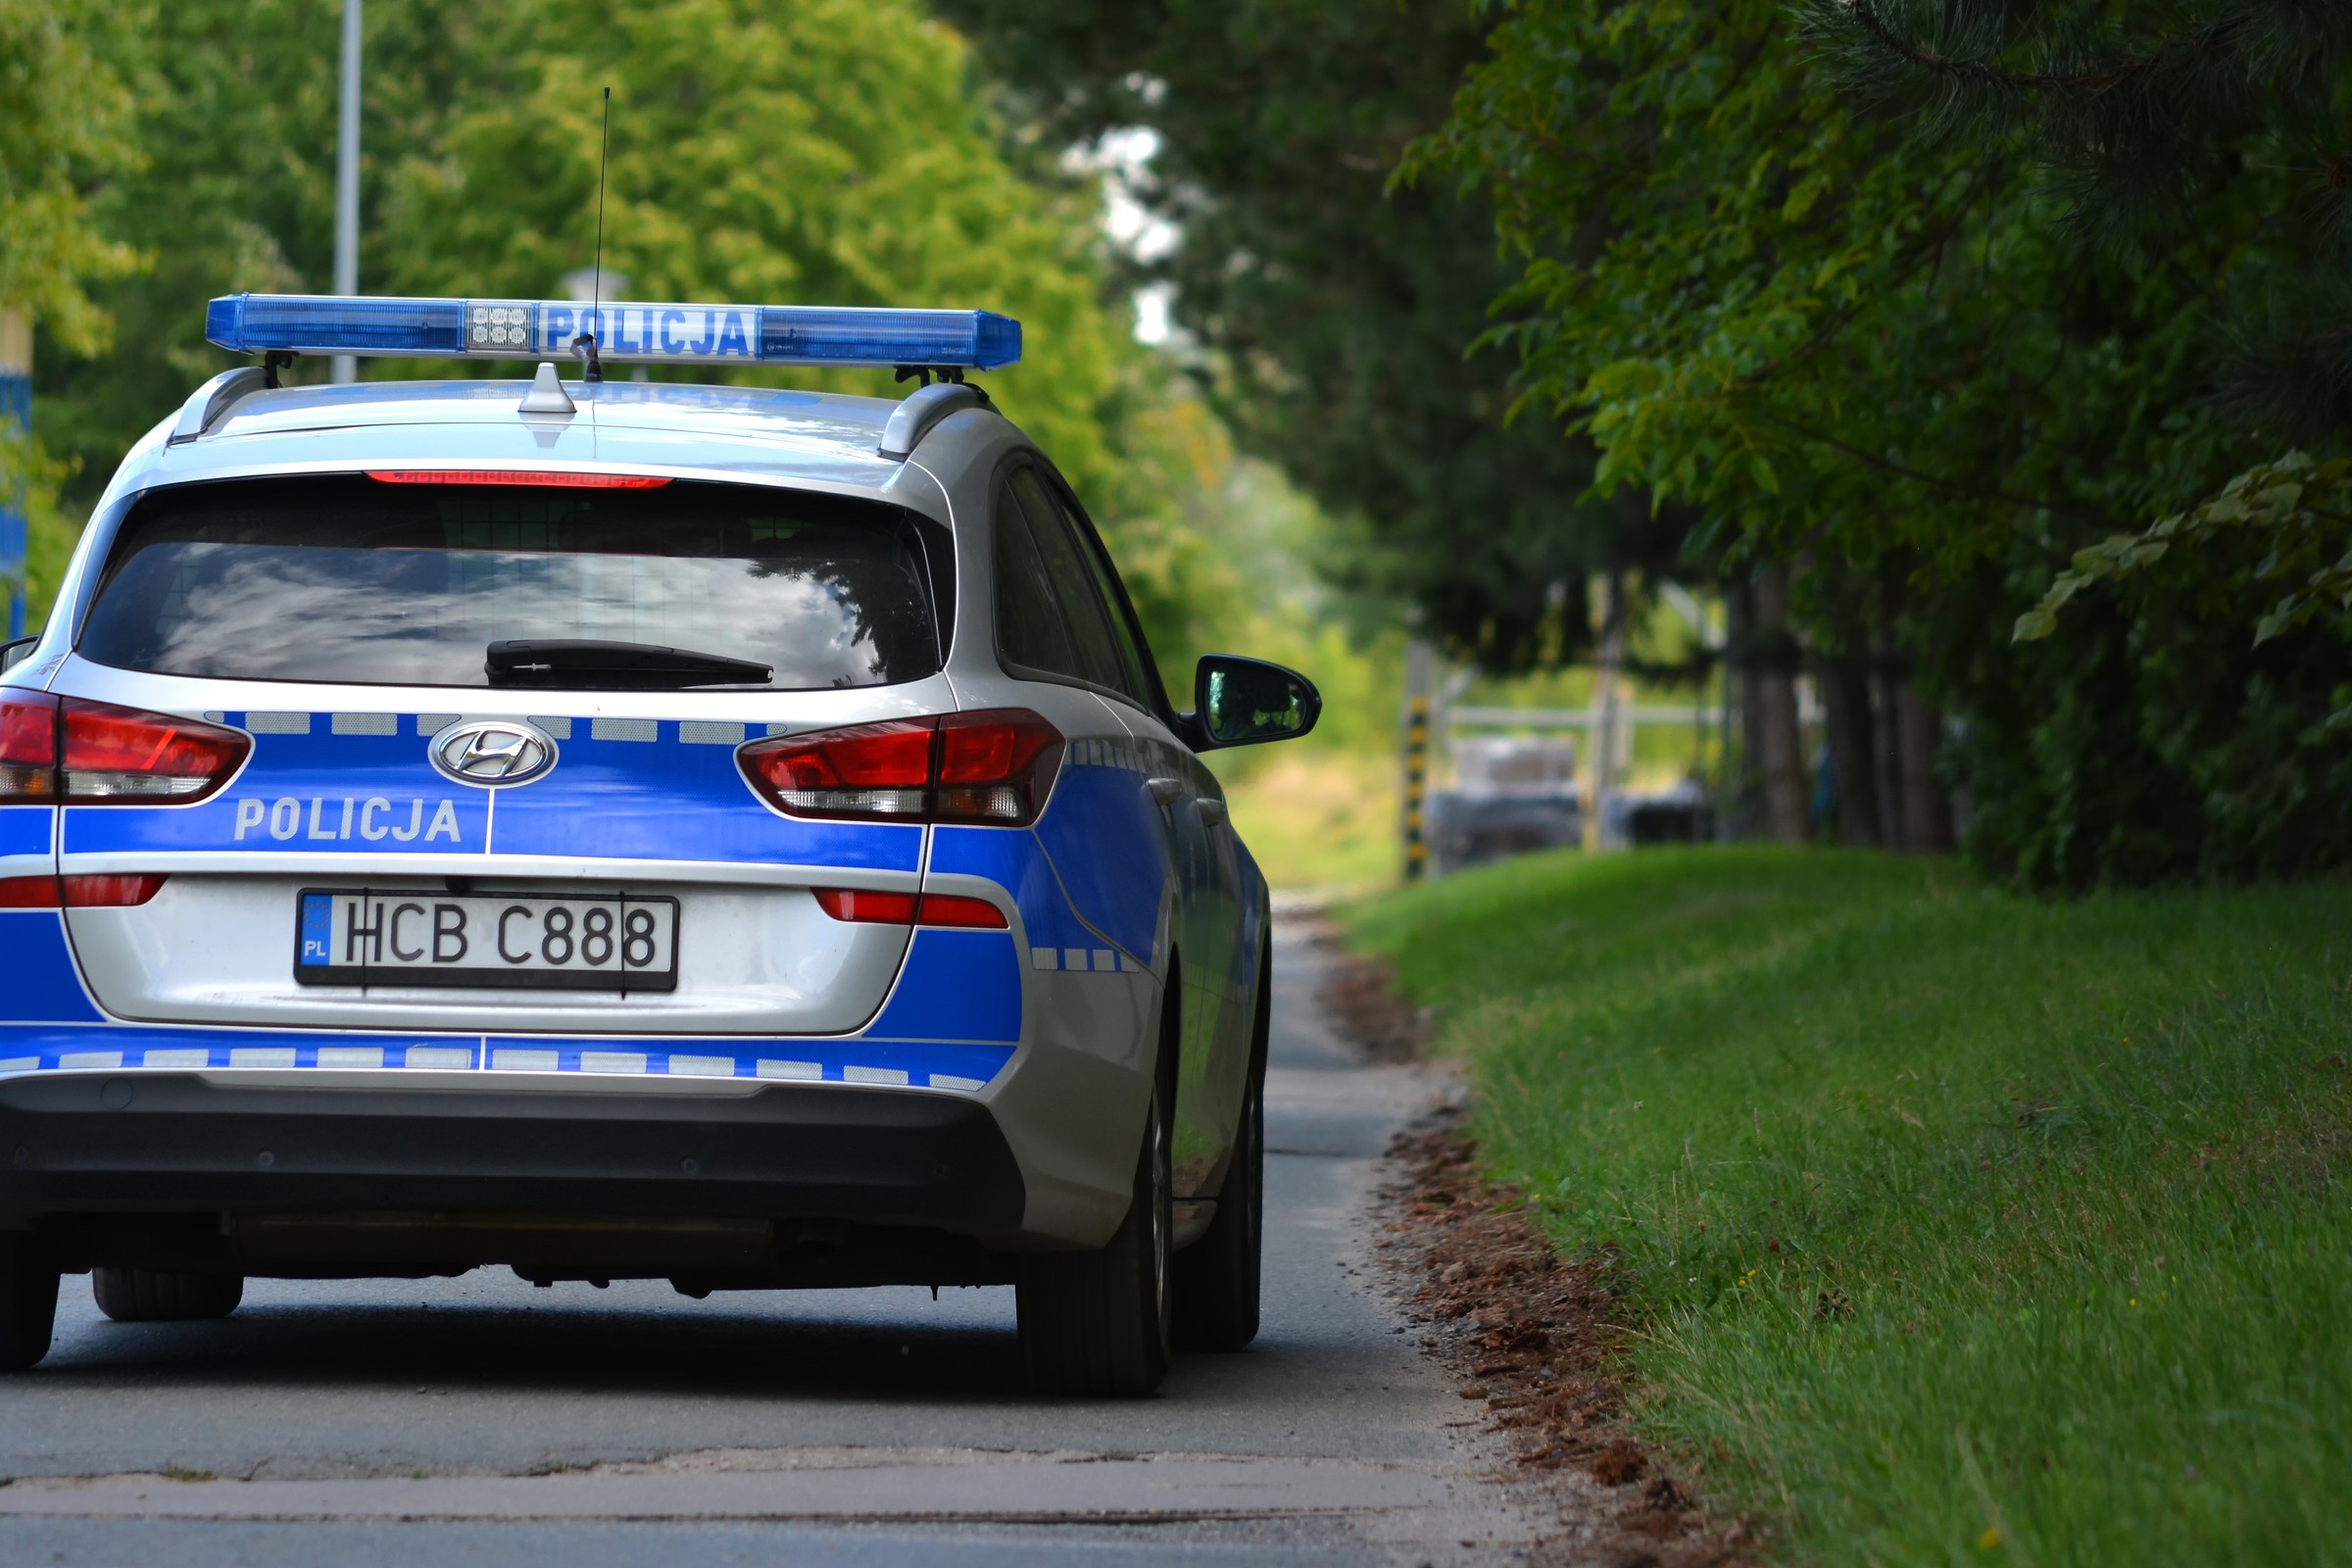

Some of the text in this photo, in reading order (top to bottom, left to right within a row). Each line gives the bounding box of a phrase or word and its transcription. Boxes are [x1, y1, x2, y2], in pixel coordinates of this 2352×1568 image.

[547, 307, 749, 357] POLICJA
[234, 797, 462, 843] POLICJA
[304, 940, 326, 956] PL
[346, 903, 656, 967] HCB C888
